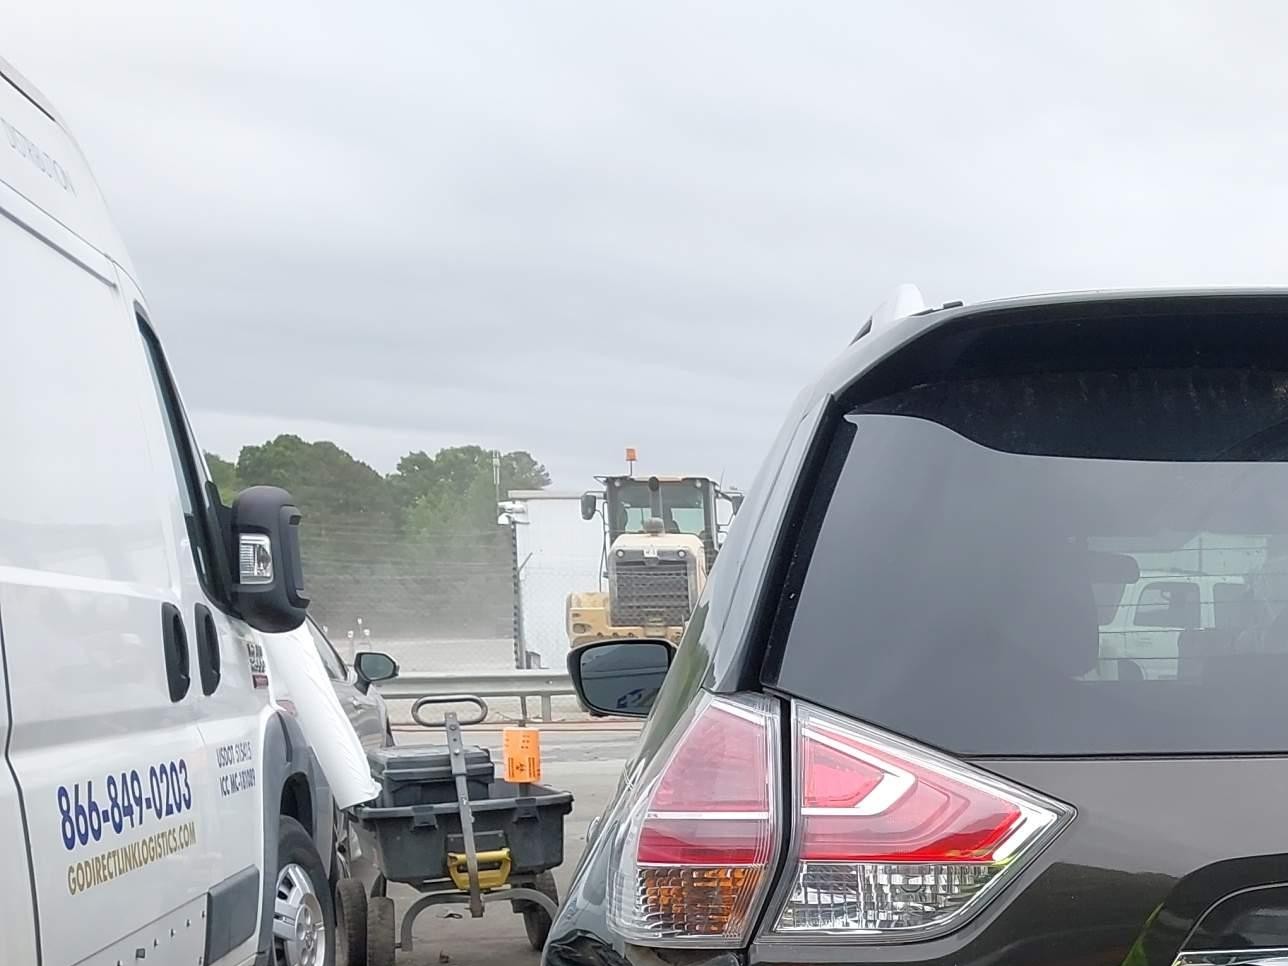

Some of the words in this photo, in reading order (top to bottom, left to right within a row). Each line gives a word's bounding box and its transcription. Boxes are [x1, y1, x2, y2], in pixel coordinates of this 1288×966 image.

[216, 744, 235, 768] USDOT
[57, 758, 192, 850] 866-849-0203
[67, 821, 197, 896] GODIRECTLINKLOGISTICS.COM
